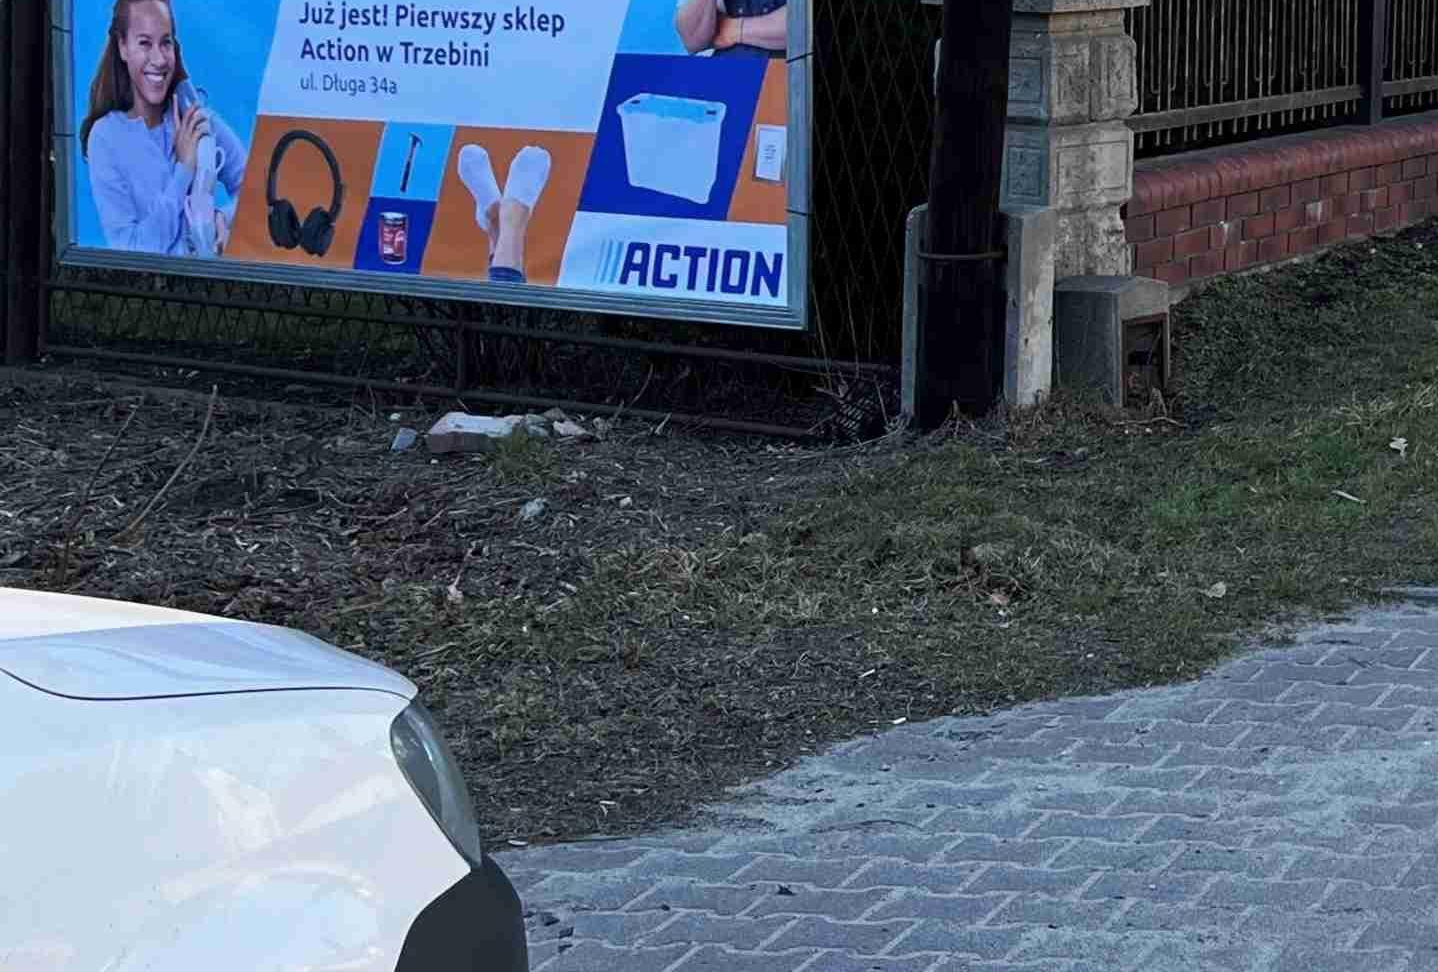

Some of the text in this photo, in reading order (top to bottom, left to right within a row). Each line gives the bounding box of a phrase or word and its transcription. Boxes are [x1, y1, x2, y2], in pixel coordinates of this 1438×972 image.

[299, 1, 566, 38] Już jest! Pierwszy sklep
[300, 37, 490, 68] Action w Trzebini
[300, 71, 398, 97] ul. Długa 34a
[618, 241, 784, 299] ACTION
